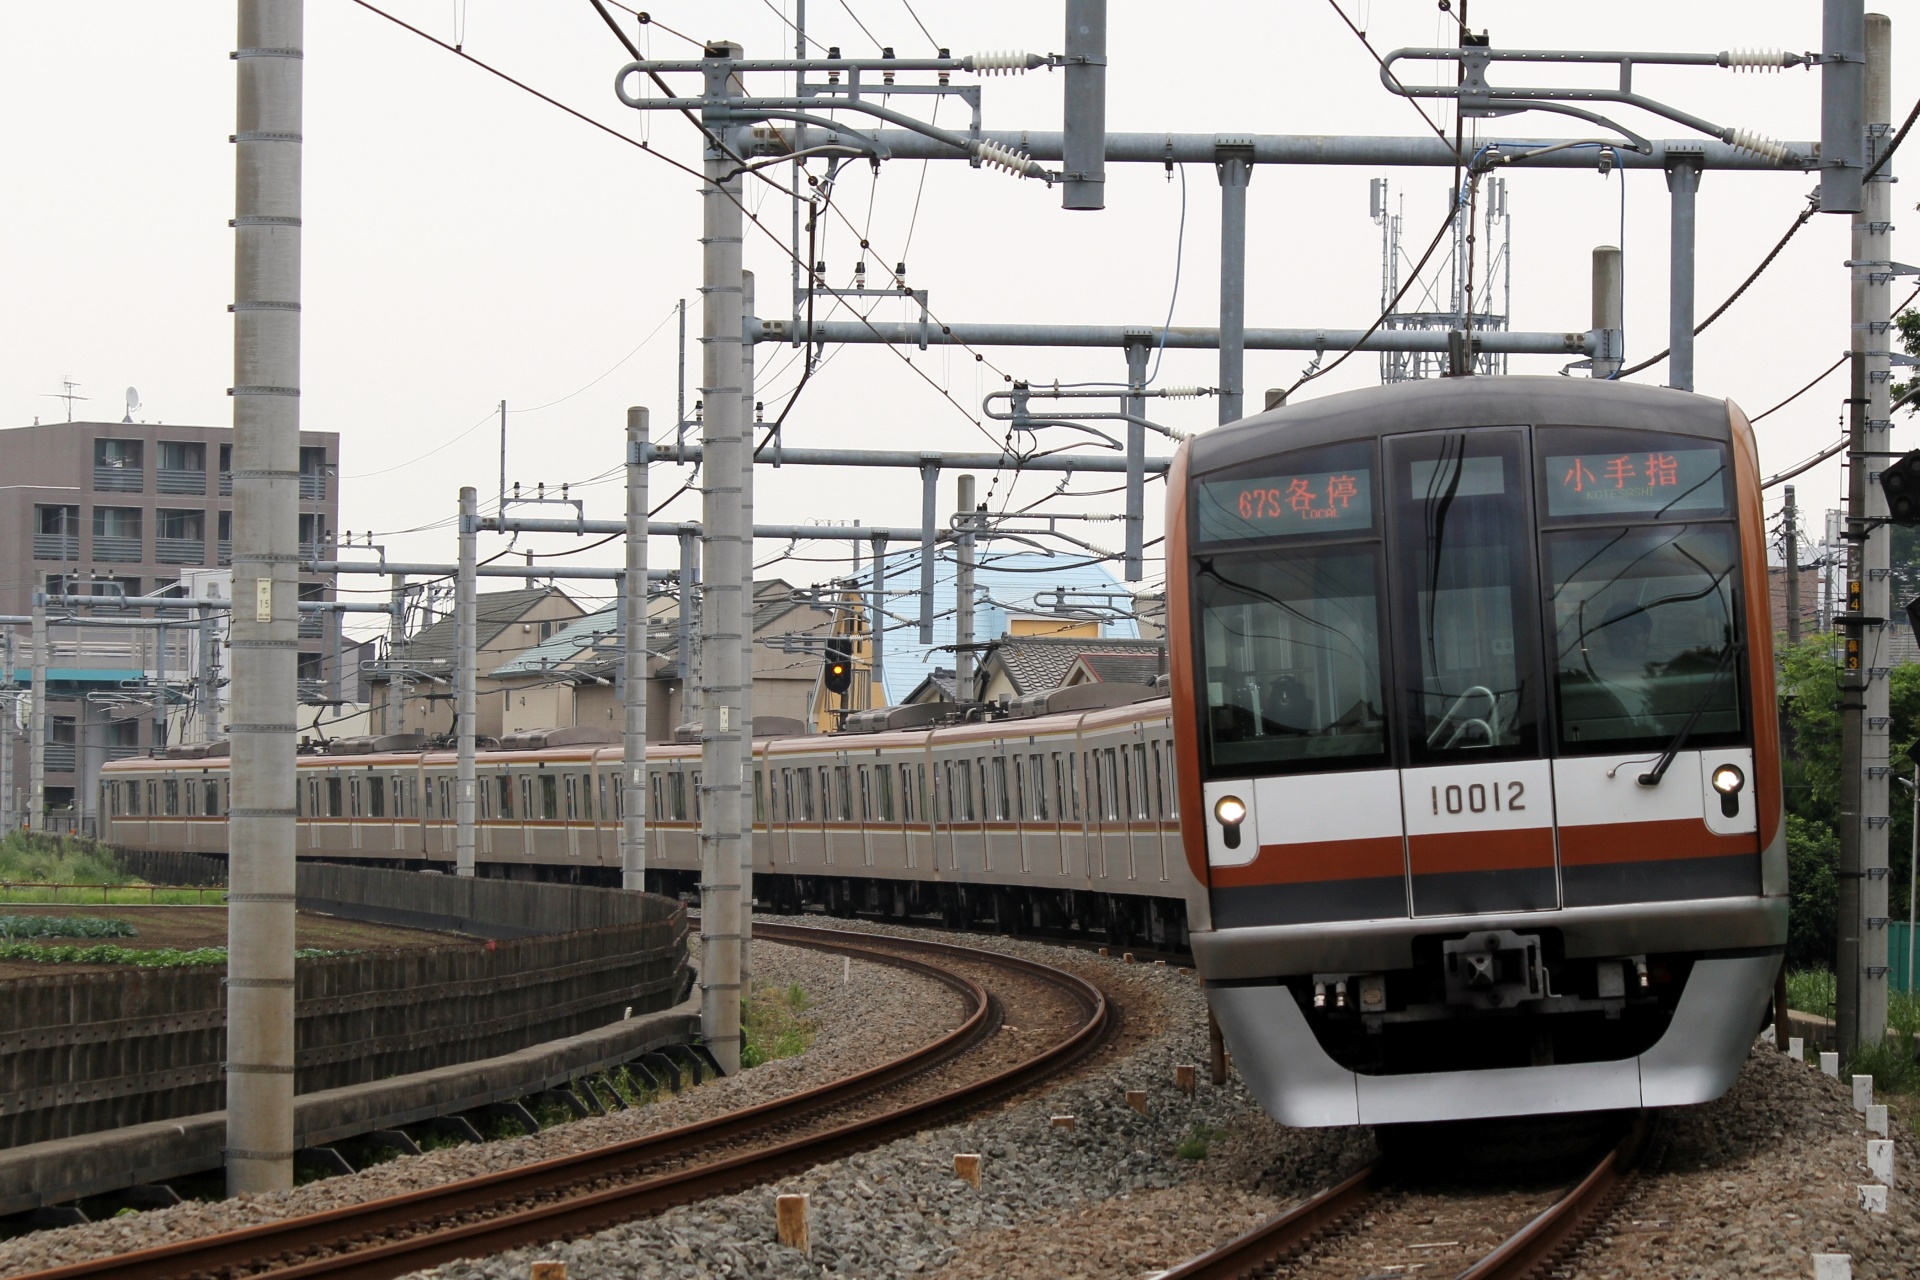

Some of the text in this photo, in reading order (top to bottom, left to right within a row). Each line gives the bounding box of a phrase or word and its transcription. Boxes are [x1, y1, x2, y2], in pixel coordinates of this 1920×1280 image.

[1563, 452, 1678, 492] 小手指
[1239, 475, 1358, 519] 67S 各停
[1586, 487, 1654, 500] KOTESASHI
[1302, 508, 1340, 519] LOCAL
[260, 599, 270, 609] 15
[1431, 781, 1526, 816] 10012
